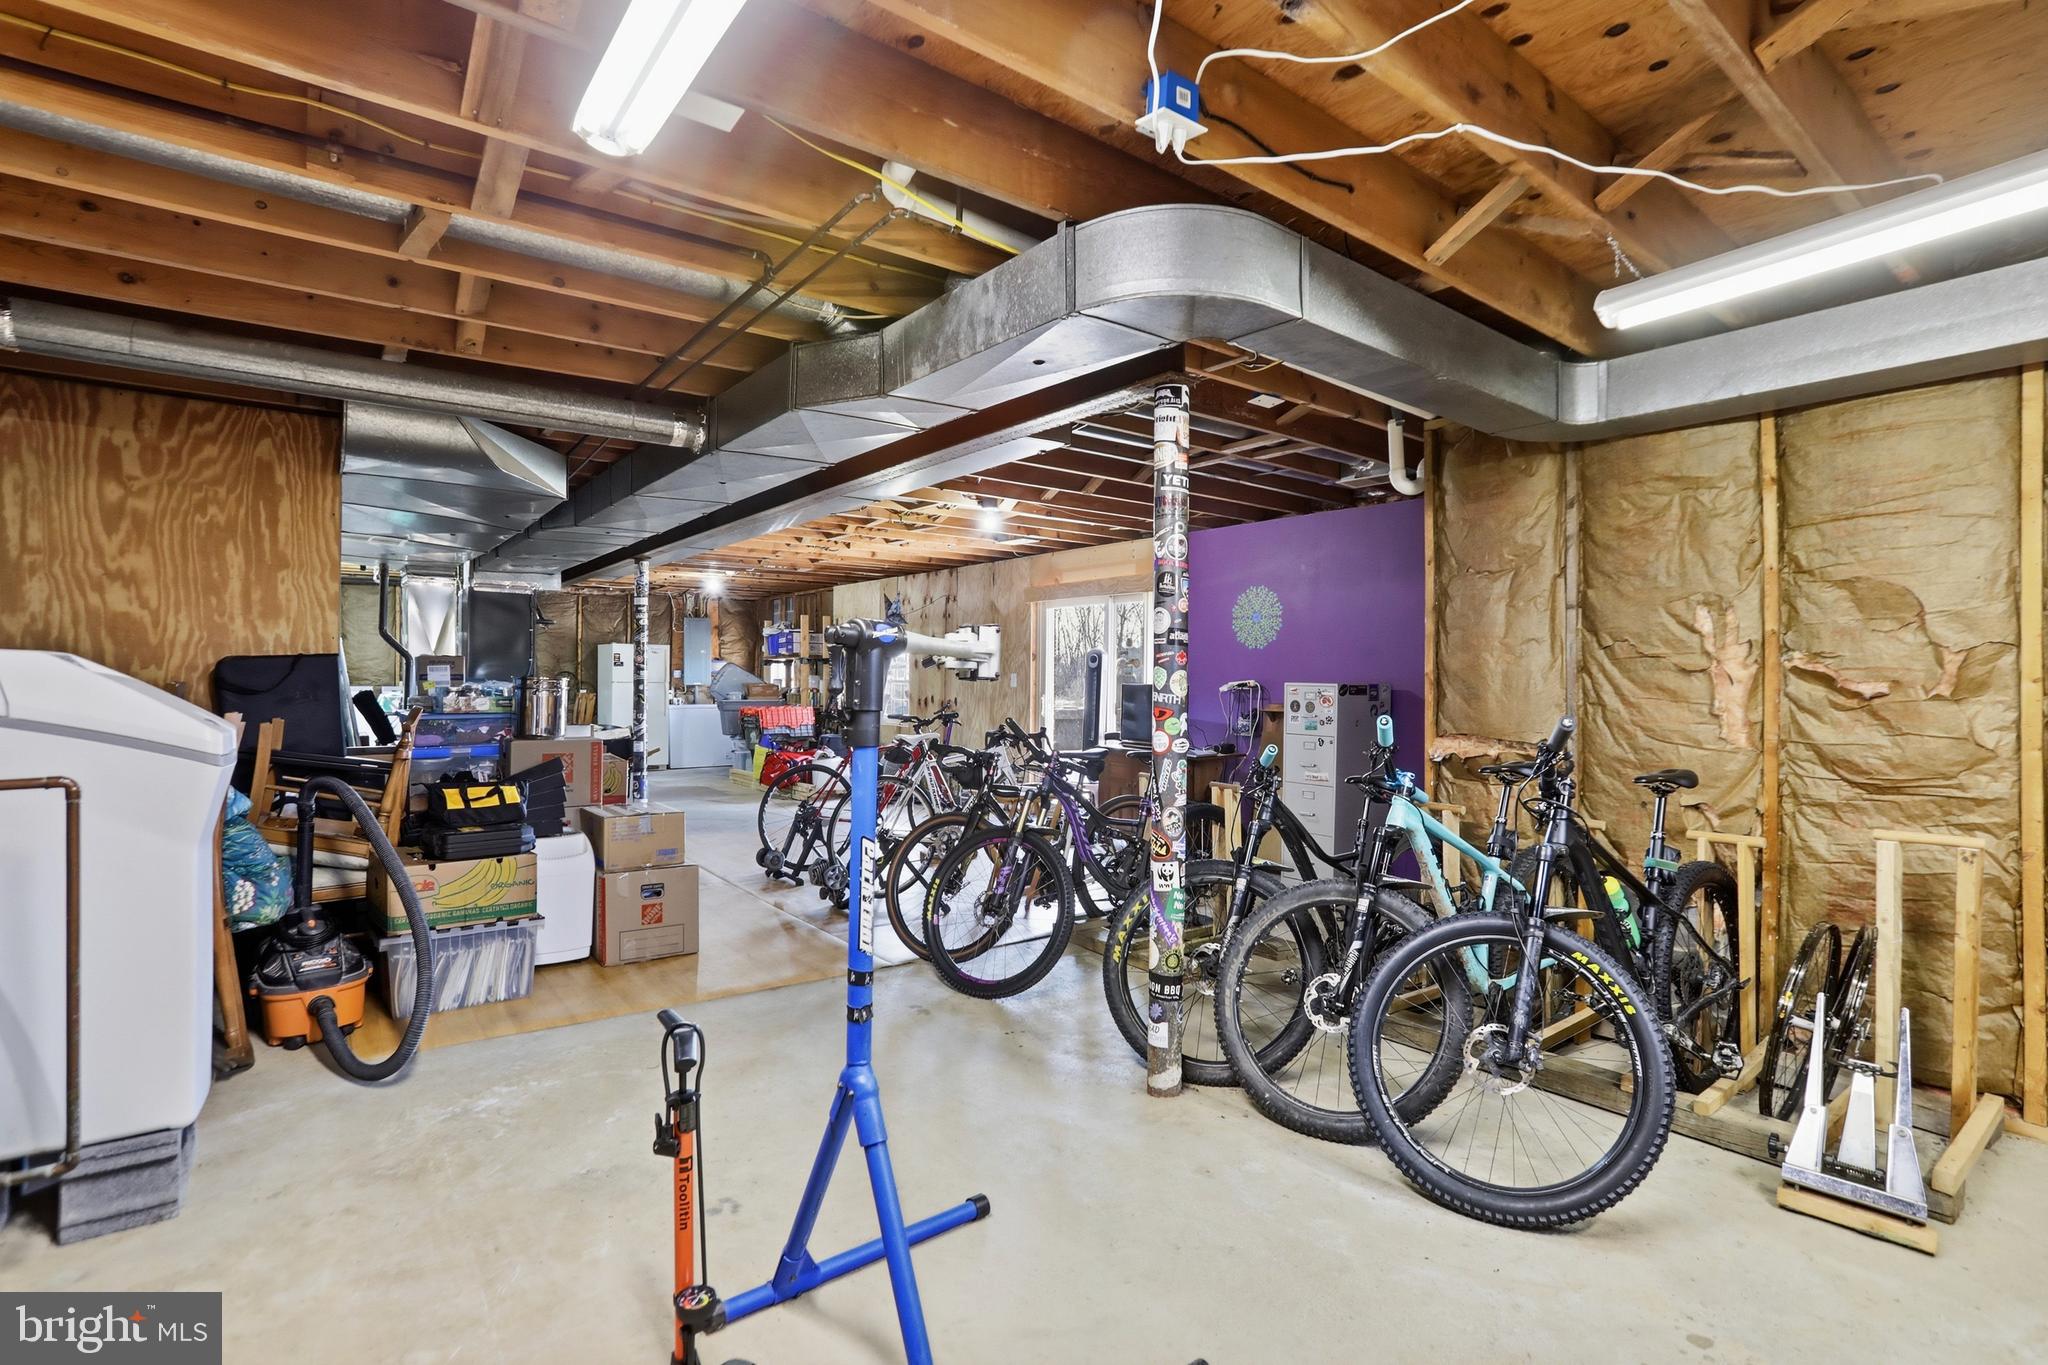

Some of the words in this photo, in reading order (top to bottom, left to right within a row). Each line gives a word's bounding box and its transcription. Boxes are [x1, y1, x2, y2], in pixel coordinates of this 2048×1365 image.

[1163, 474, 1189, 488] YETI
[491, 878, 535, 890] ORGANIC
[1571, 951, 1637, 1015] MAXXIS
[1164, 985, 1181, 996] BBQ
[679, 1174, 691, 1231] Toolitin
